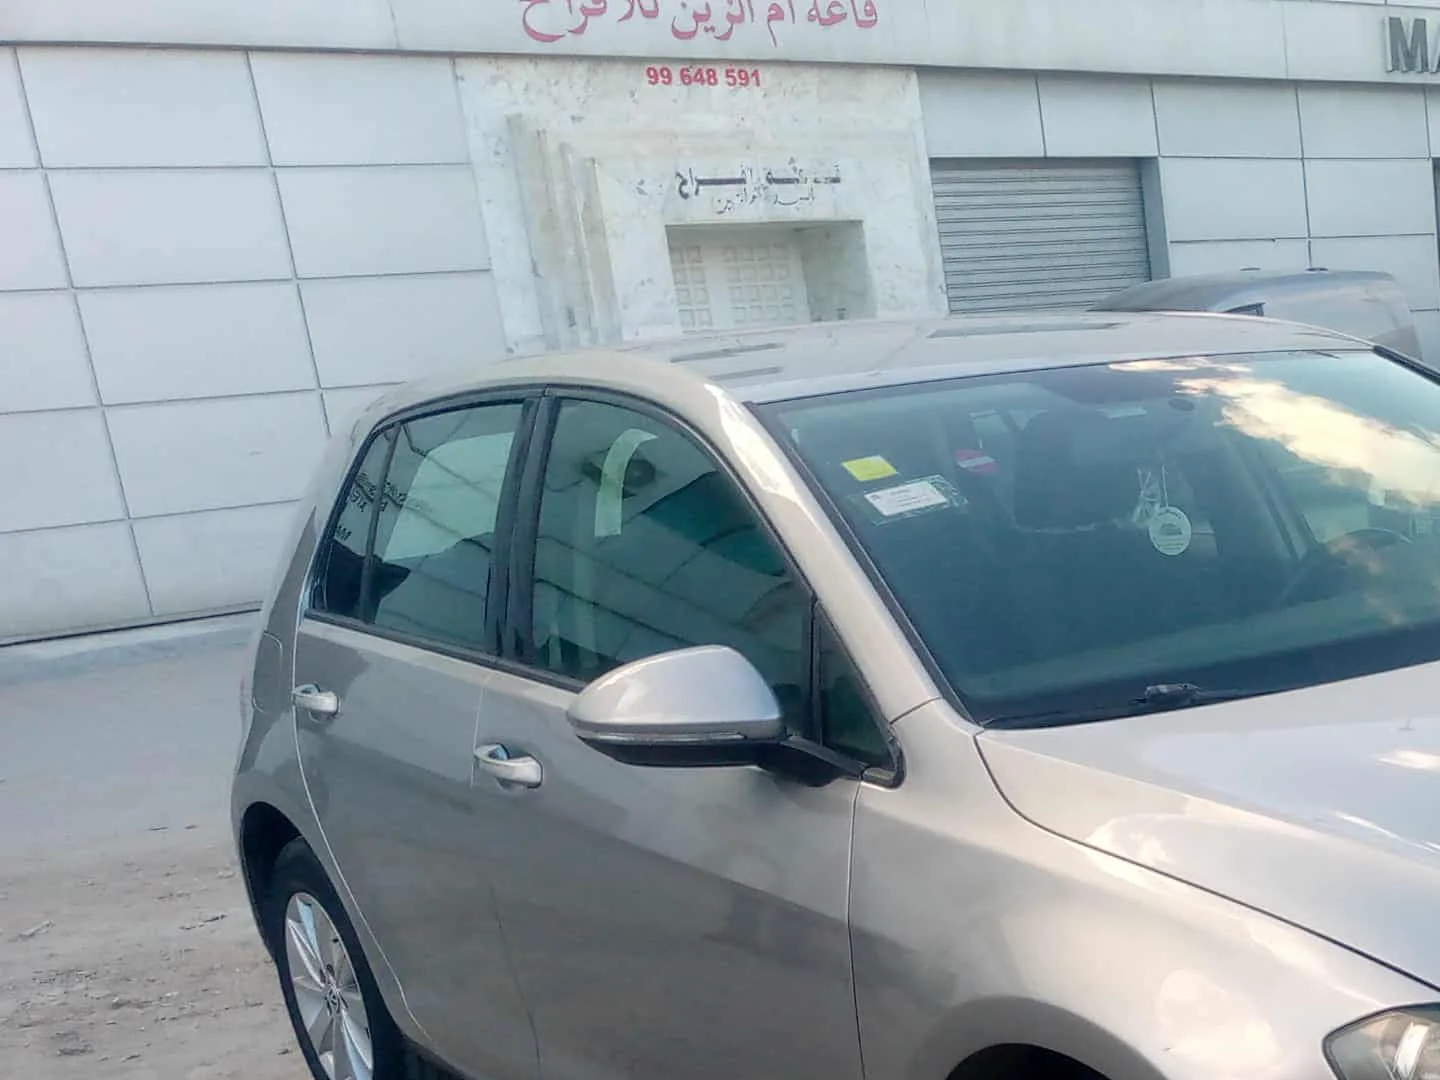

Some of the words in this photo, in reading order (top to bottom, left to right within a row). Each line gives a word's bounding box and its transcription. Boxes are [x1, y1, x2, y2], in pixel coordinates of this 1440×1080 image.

[646, 66, 672, 85] 99
[680, 67, 718, 86] 648
[725, 68, 761, 88] 591
